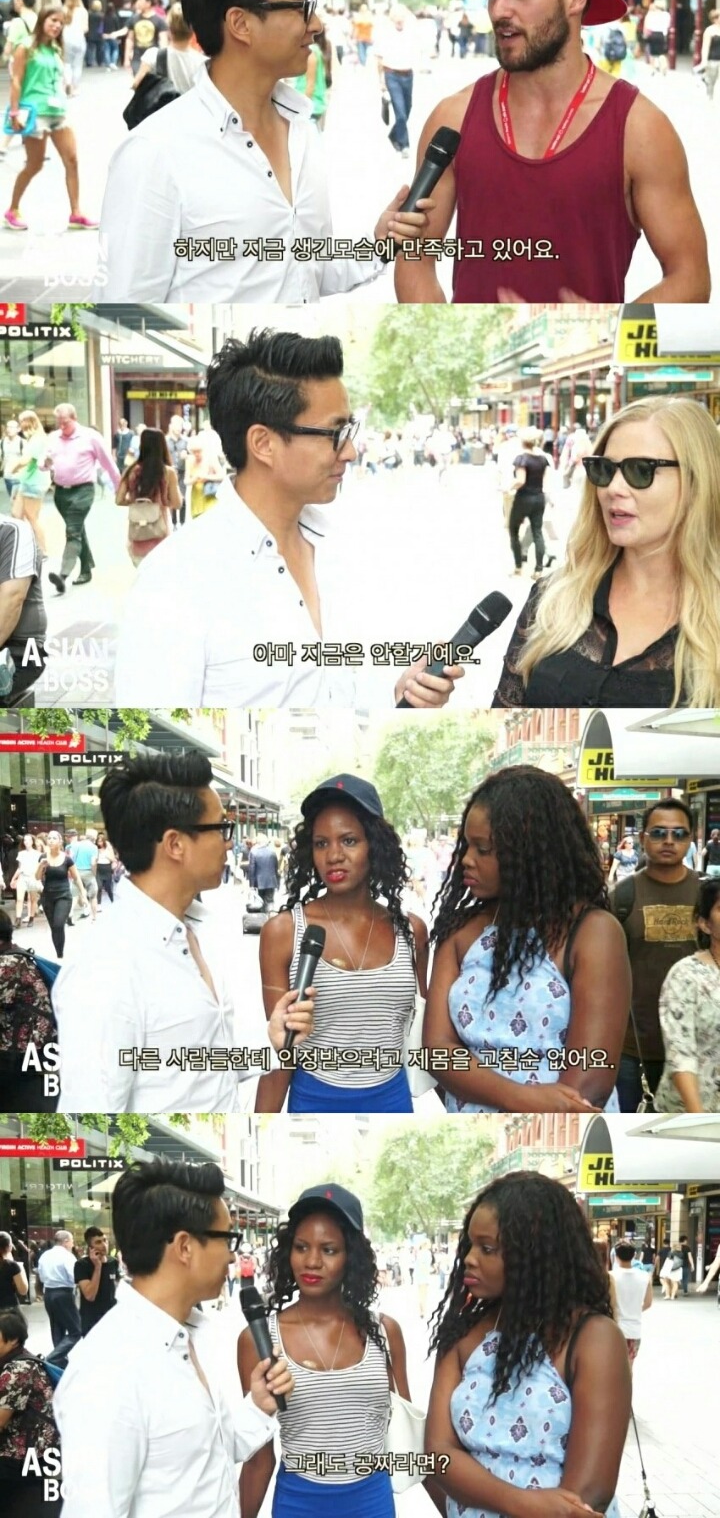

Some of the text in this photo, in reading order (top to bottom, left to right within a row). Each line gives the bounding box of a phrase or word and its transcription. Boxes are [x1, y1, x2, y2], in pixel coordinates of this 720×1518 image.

[0, 326, 71, 337] POLITIX
[101, 354, 161, 364] WITCHERY
[59, 754, 124, 763] POLITIX
[59, 1159, 124, 1168] POLITIX
